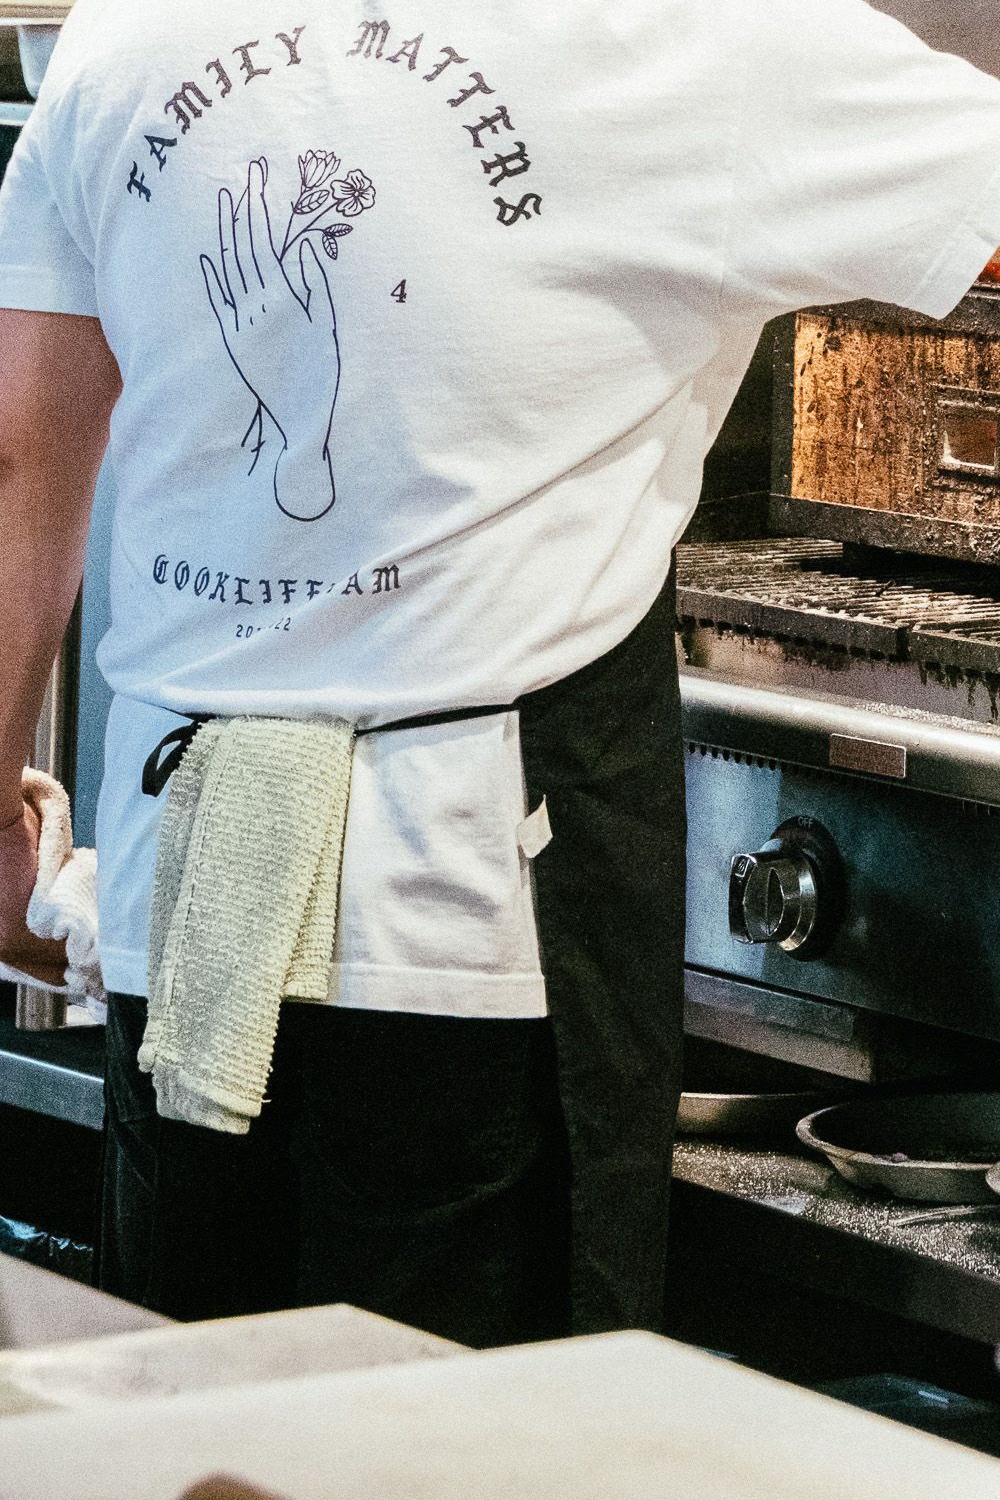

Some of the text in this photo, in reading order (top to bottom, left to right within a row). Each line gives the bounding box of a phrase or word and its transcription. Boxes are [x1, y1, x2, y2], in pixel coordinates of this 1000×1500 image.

[126, 20, 542, 227] FAMILY MATTERS
[390, 278, 407, 303] 4
